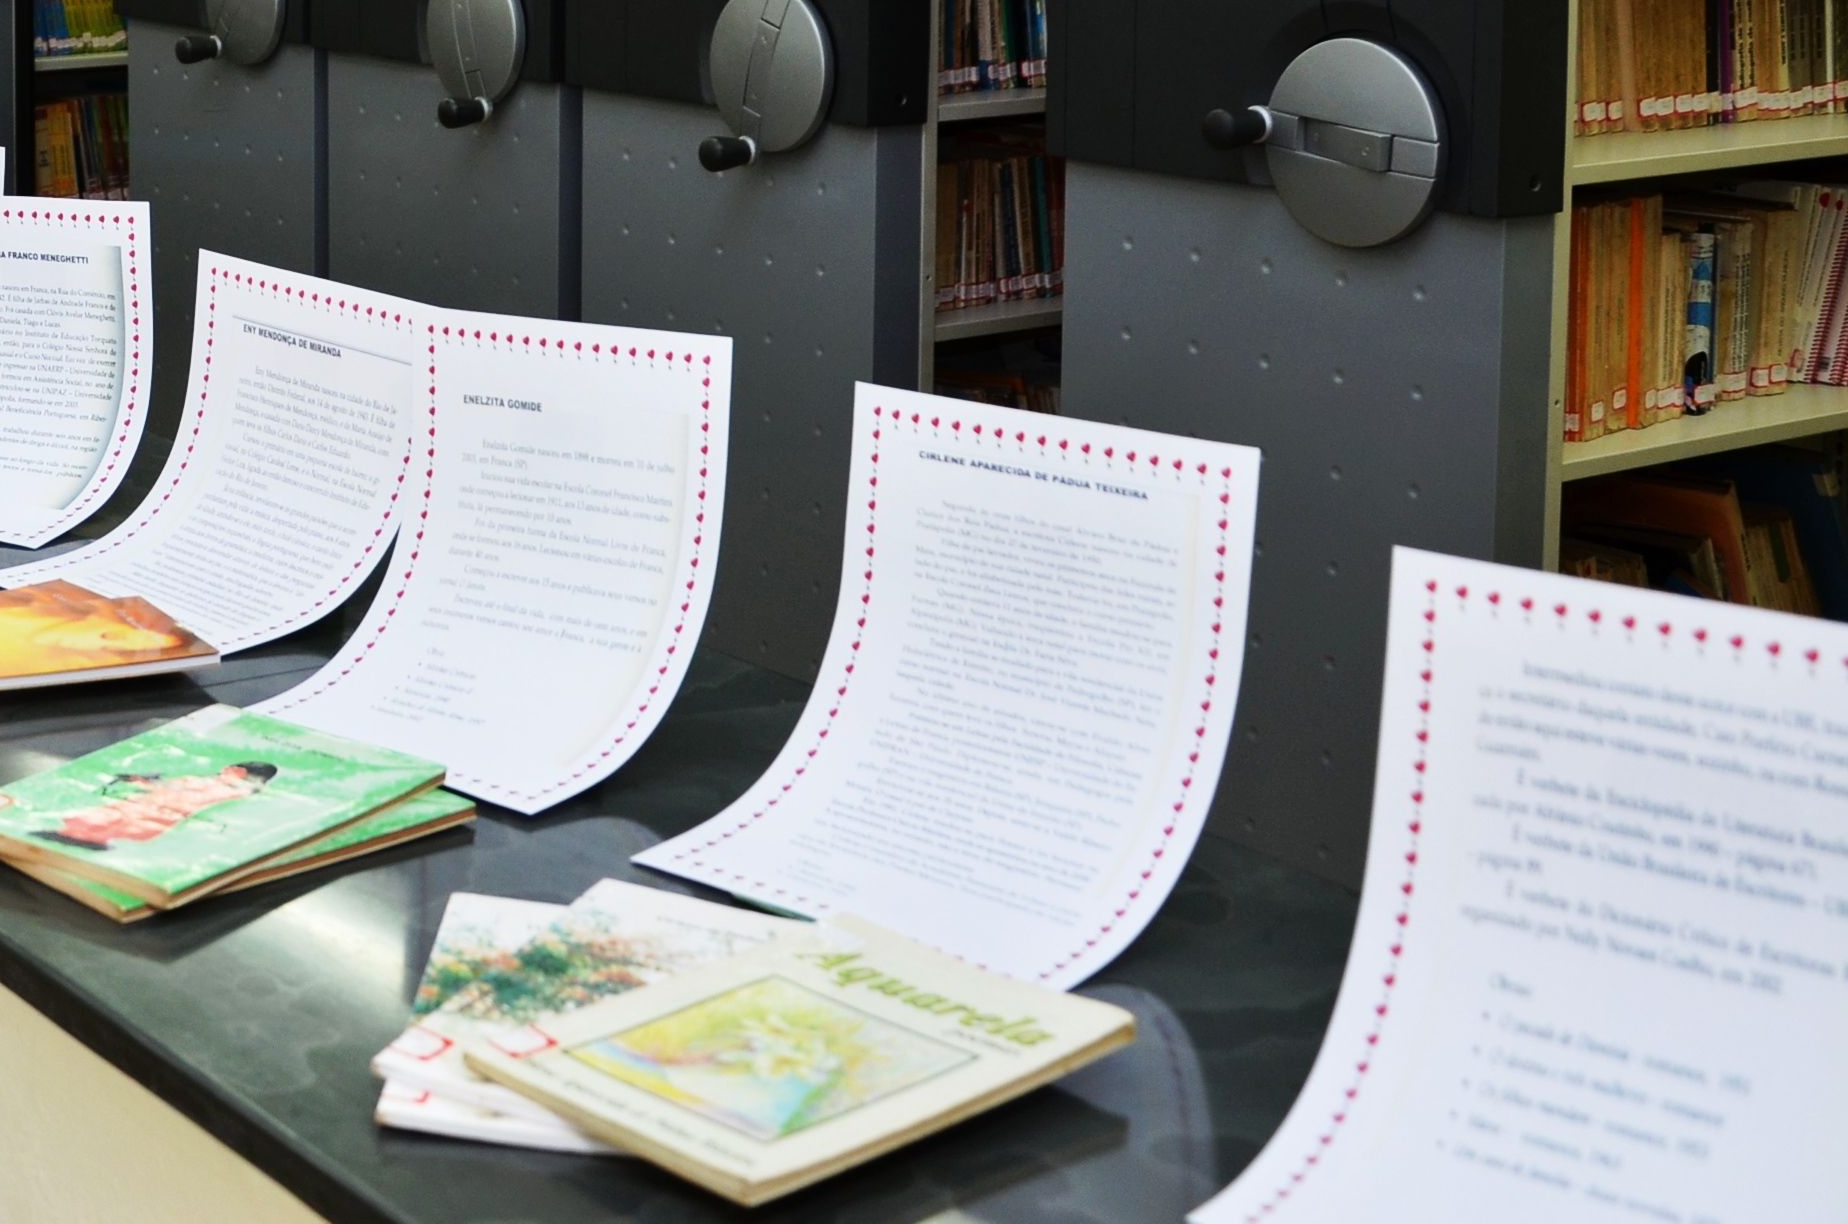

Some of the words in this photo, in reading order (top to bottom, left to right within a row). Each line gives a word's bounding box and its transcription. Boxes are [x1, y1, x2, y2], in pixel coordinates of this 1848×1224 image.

[7, 251, 39, 261] FRANCO
[40, 253, 90, 264] MENEGHETTI
[243, 323, 257, 335] ENY
[258, 327, 297, 348] MENDONÇA
[298, 339, 308, 350] DE
[309, 341, 342, 358] MIRANDA
[462, 394, 505, 407] ENELZITA
[507, 398, 543, 412] GOMIDE
[918, 449, 966, 467] CIRLENE
[969, 459, 1032, 479] APARECIDA
[1034, 471, 1050, 482] DE
[1052, 474, 1091, 490] PÁDUA
[1095, 482, 1150, 501] TEIXEIRA
[794, 950, 1054, 1047] Aquarela
